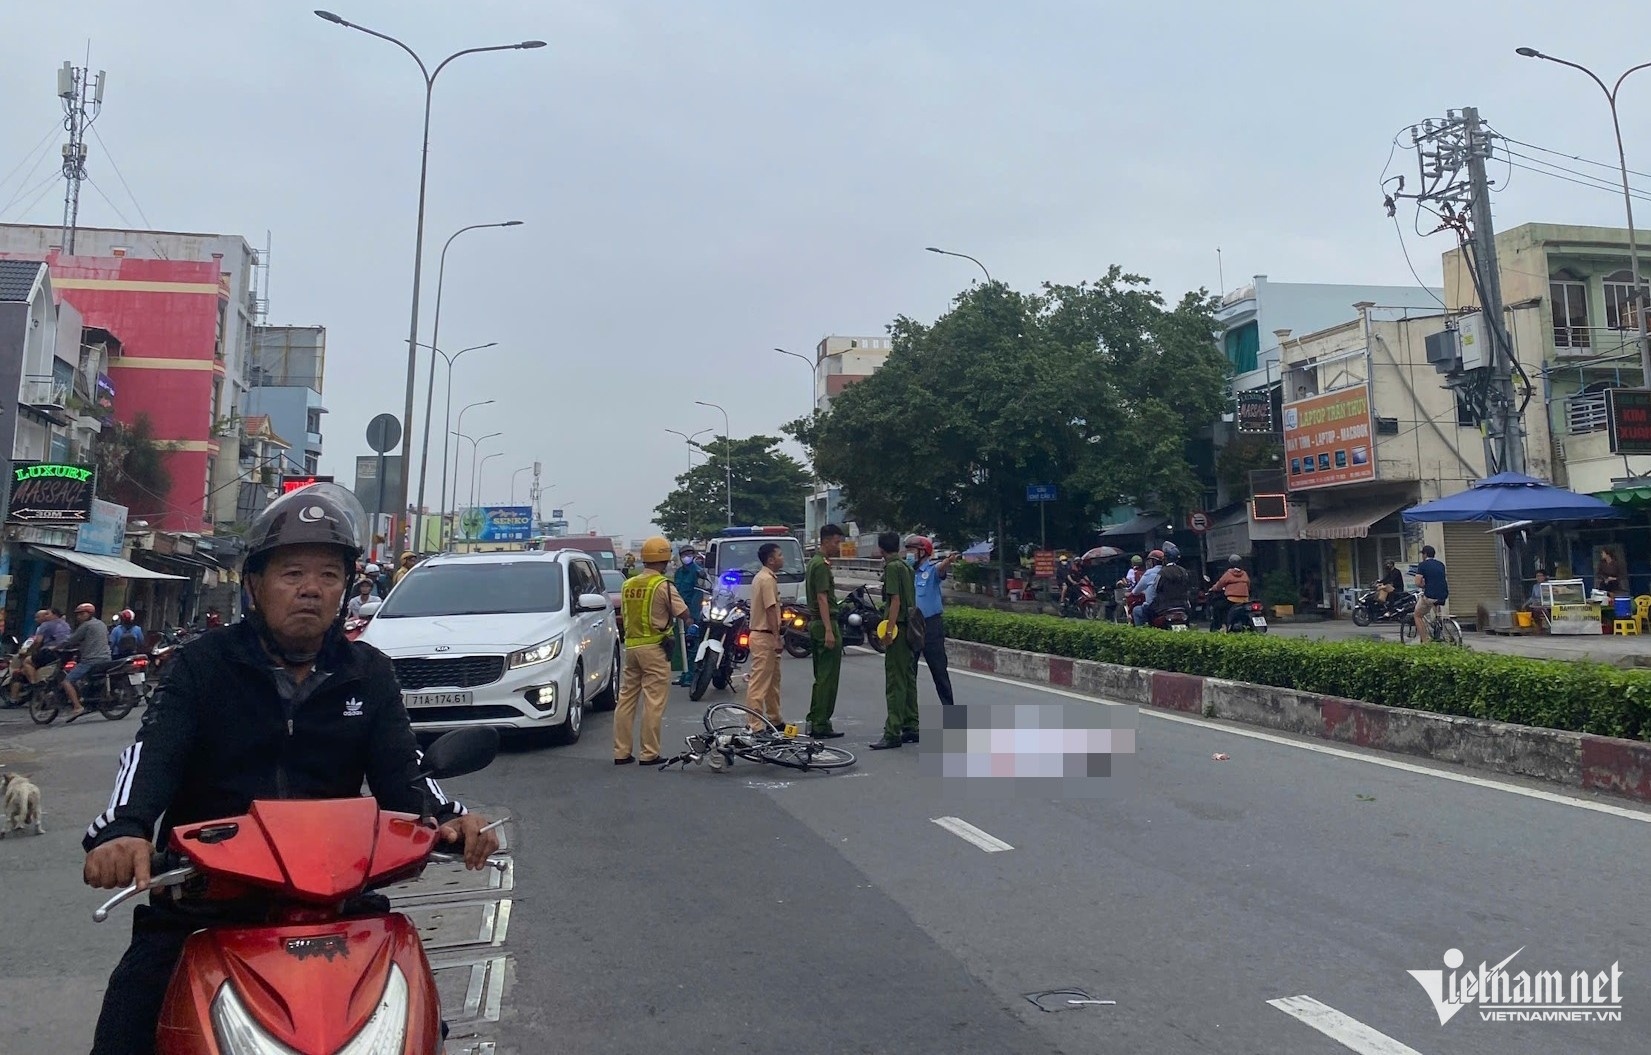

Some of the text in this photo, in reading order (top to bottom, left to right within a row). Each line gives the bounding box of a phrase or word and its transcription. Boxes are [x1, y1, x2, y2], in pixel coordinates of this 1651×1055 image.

[1241, 403, 1268, 418] MASSAGE
[1300, 407, 1326, 427] LAPTOP
[1622, 409, 1646, 421] KIM
[15, 465, 93, 482] LUXURY
[11, 480, 87, 509] MASSAGE
[493, 517, 529, 525] SENKO
[625, 588, 646, 598] CSGT
